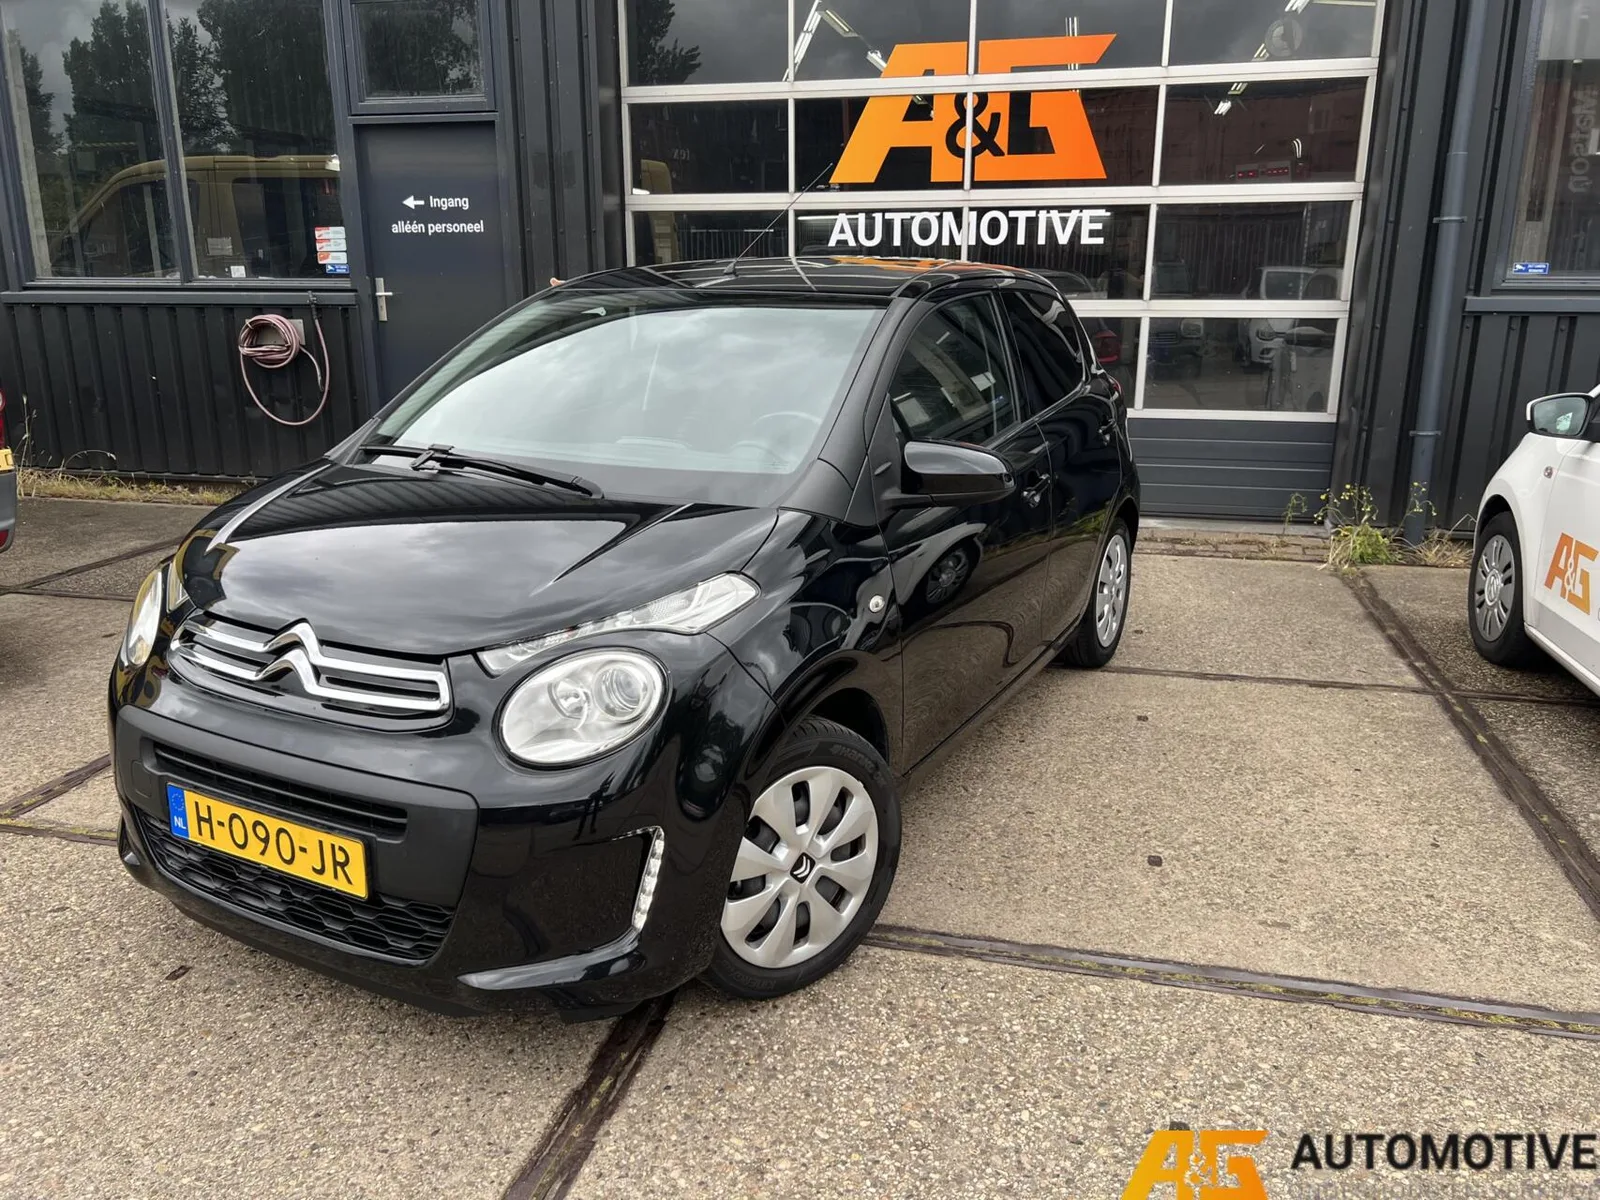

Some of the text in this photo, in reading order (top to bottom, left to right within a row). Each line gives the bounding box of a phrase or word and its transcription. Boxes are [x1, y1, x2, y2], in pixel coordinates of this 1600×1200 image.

[829, 34, 1117, 183] A&G
[429, 195, 469, 210] Ingang
[391, 220, 484, 236] alléén personeel
[828, 209, 1105, 247] AUTOMOTIVE
[1544, 532, 1599, 615] A&G
[174, 815, 187, 830] NL
[194, 801, 353, 885] H-090-JR
